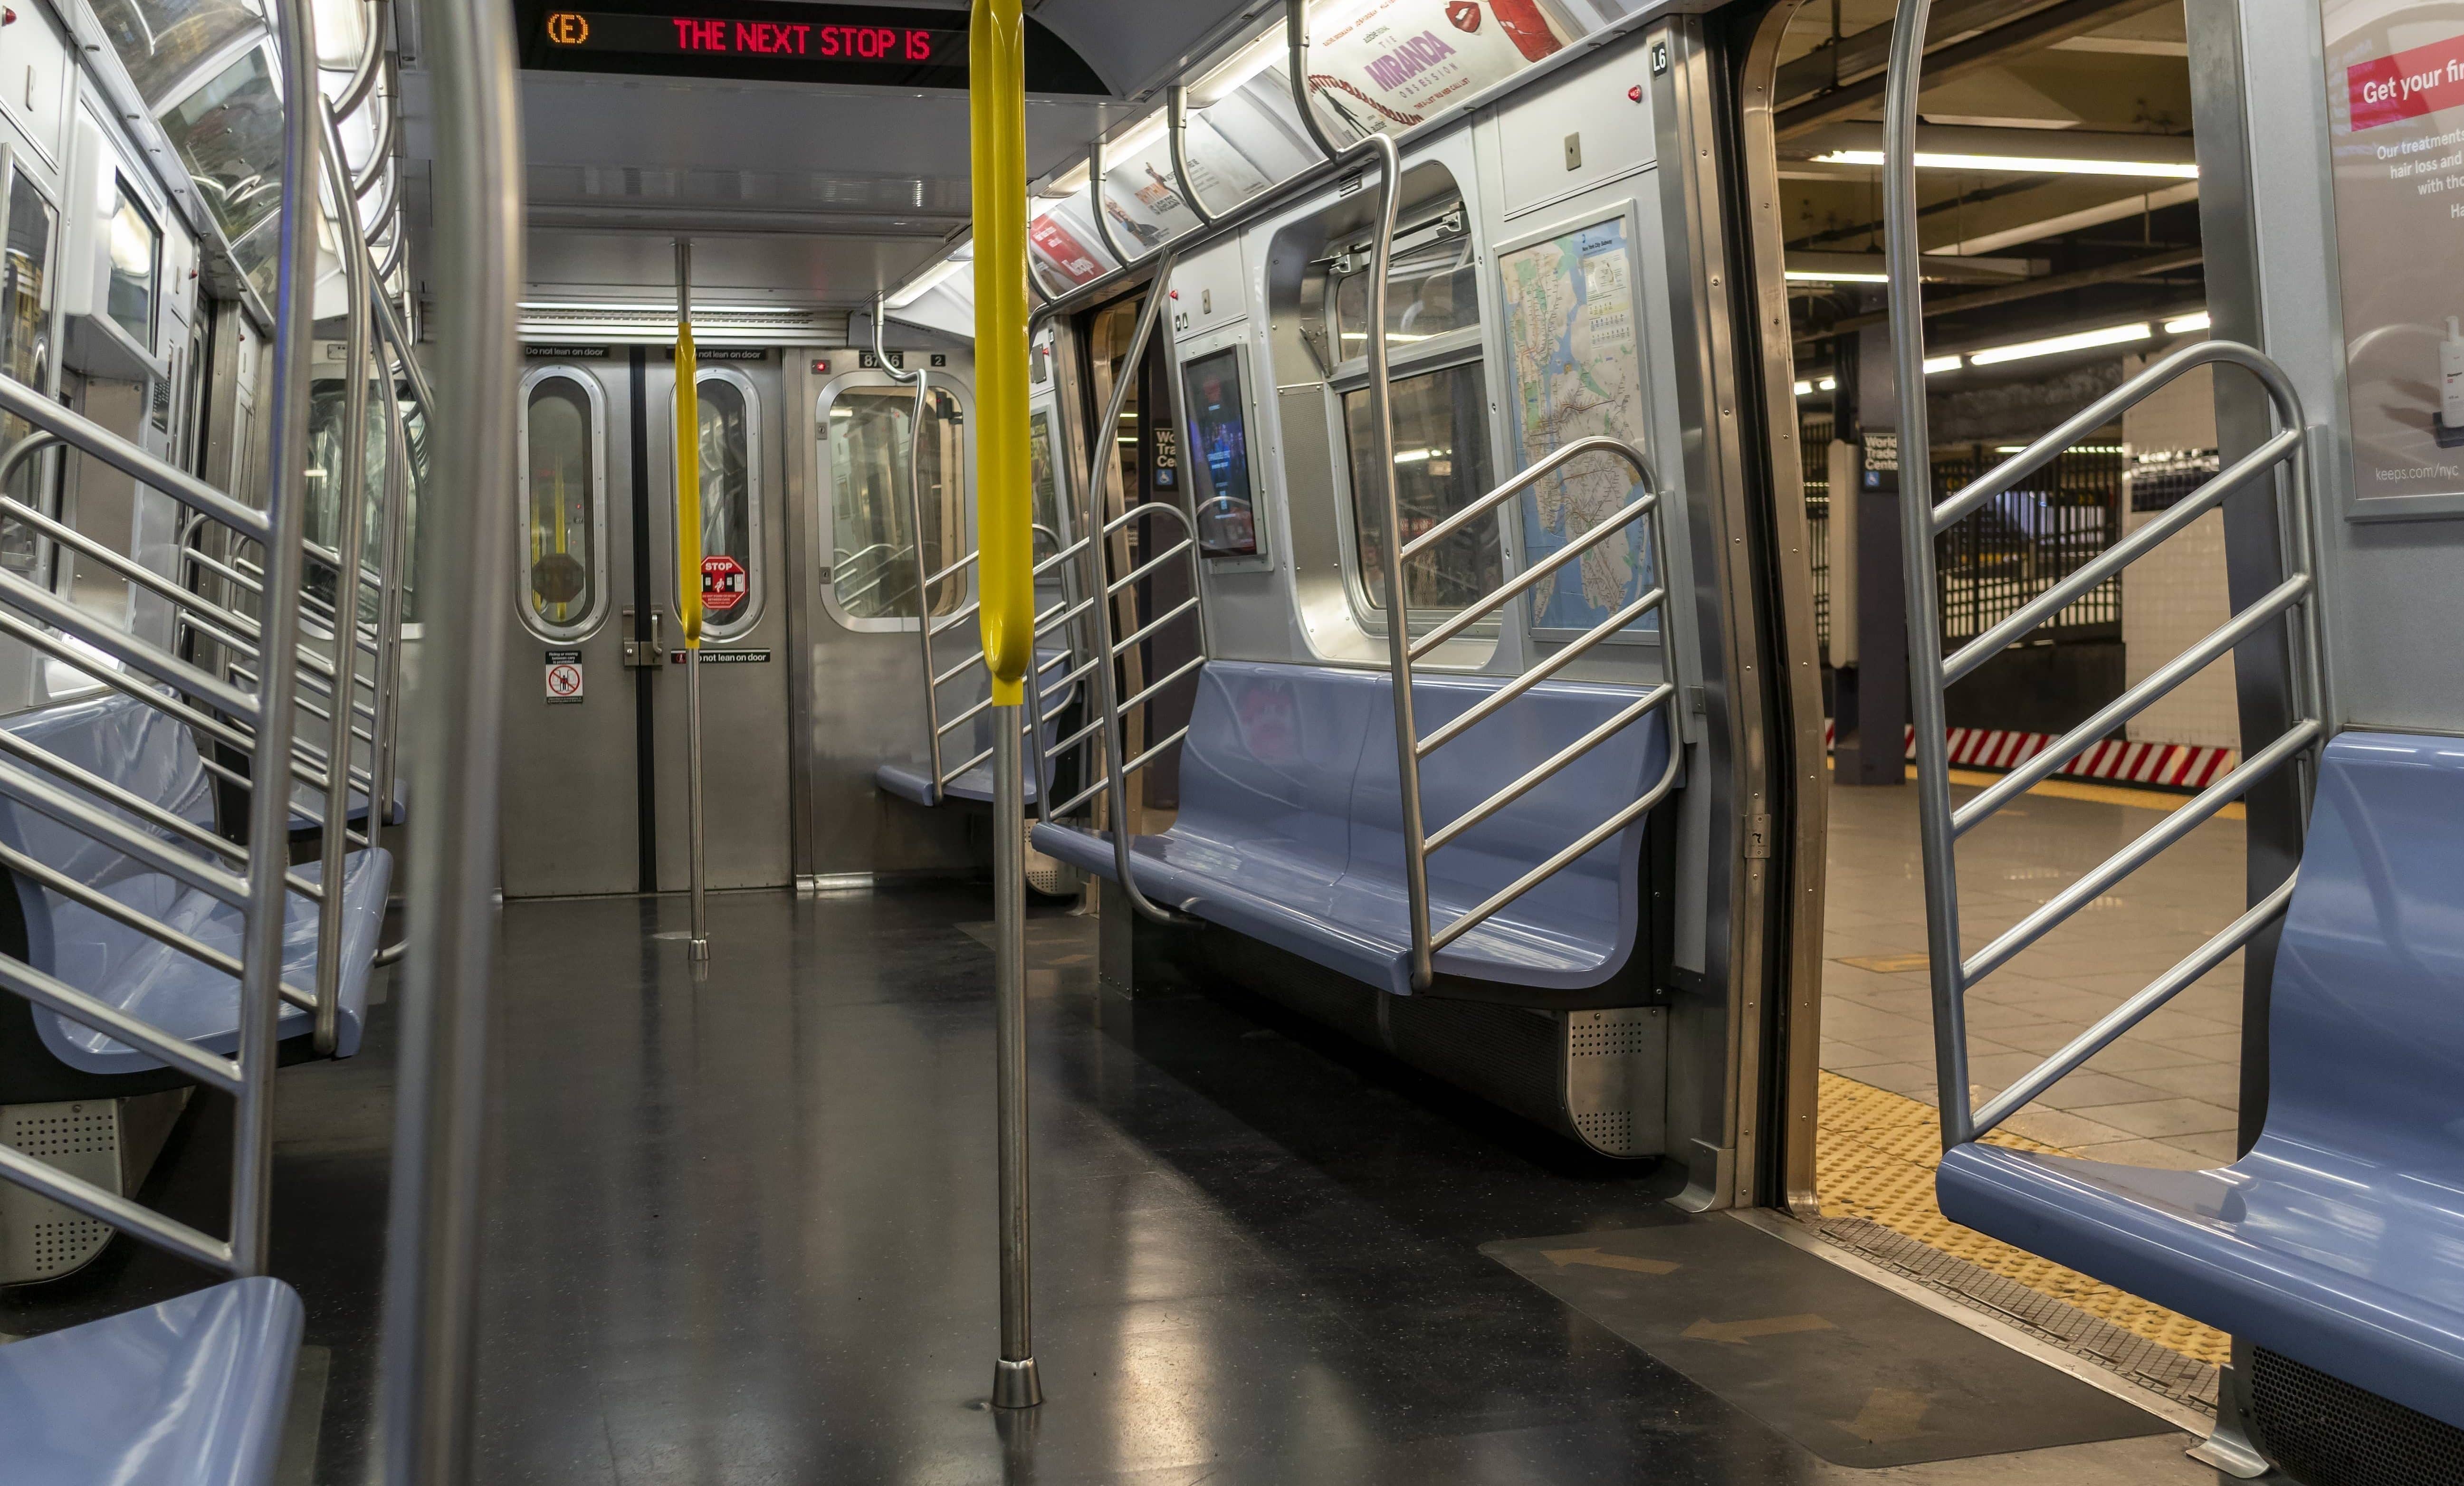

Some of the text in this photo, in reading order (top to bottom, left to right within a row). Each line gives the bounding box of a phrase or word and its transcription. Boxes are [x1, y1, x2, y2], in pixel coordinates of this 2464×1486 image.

[548, 14, 589, 44] (E)
[673, 18, 930, 60] THE NEXT STOP IS
[1364, 30, 1457, 92] MIRANDA
[1652, 48, 1666, 71] L6
[1399, 62, 1459, 98] OBSESSION
[2363, 76, 2397, 104] Get
[2400, 68, 2443, 100] your
[2377, 145, 2399, 160] Our
[2390, 150, 2462, 179] hair loss and
[2417, 177, 2443, 195] with
[554, 347, 570, 355] lean
[584, 348, 604, 356] door
[713, 350, 728, 358] lean
[742, 351, 761, 359] door
[935, 356, 942, 365] 2
[864, 355, 899, 367] 876
[1864, 448, 1897, 459] Trade
[2376, 463, 2459, 483] keeps.com/nyc
[705, 562, 733, 571] STOP
[718, 653, 735, 662] lean
[748, 653, 766, 661] door
